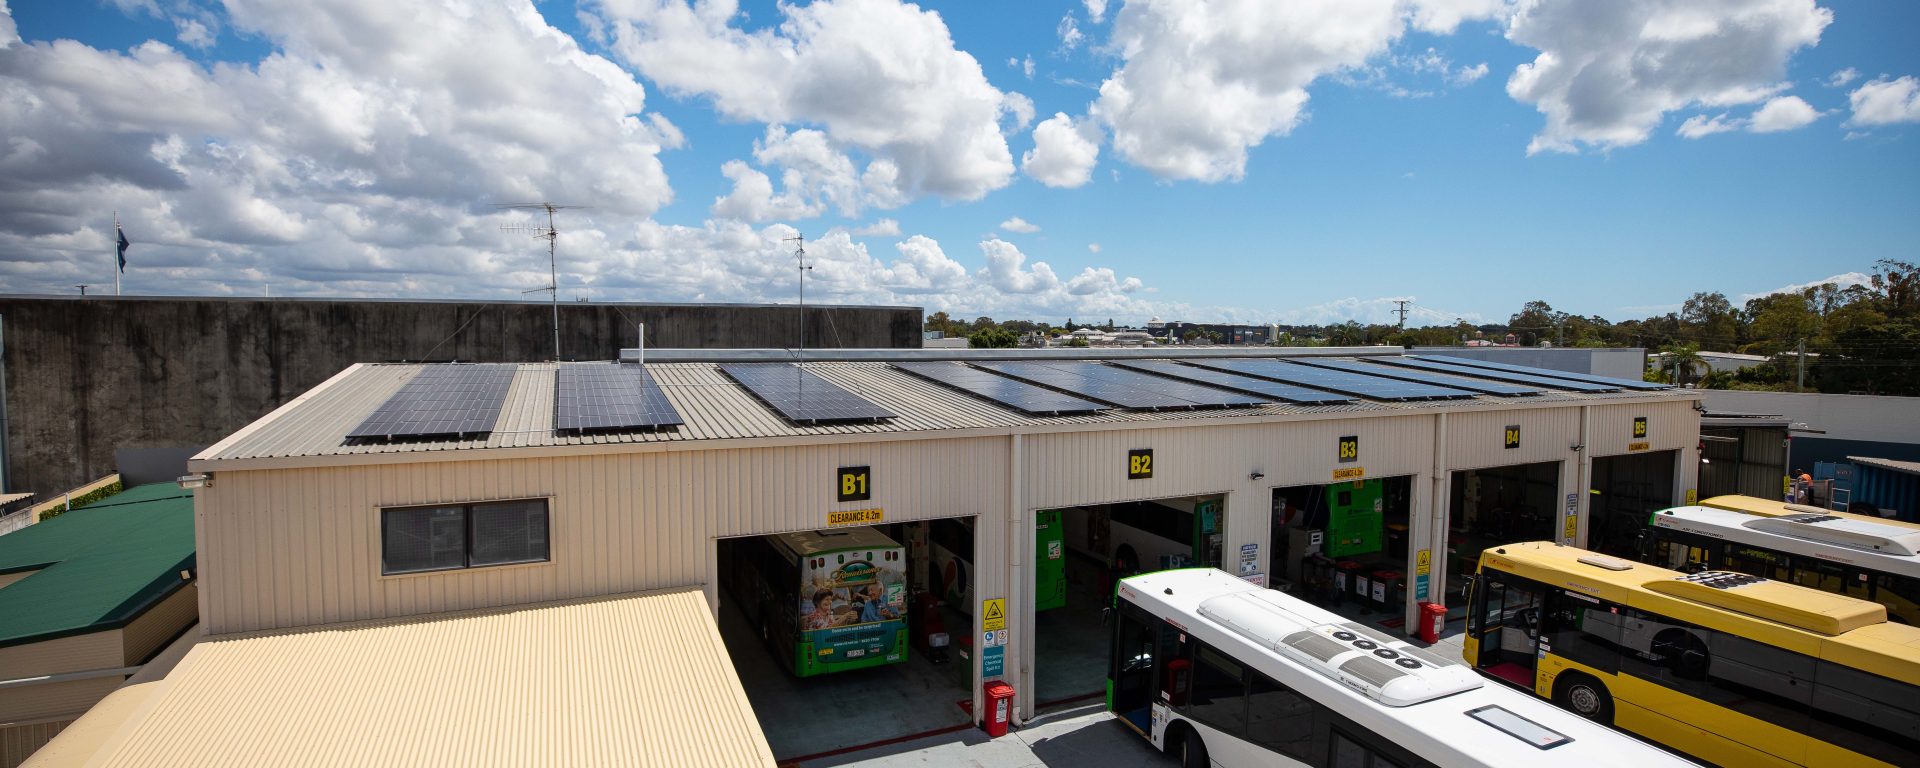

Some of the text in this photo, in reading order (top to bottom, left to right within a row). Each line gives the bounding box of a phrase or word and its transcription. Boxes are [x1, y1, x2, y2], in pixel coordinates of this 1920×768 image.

[1635, 421, 1646, 434] B5
[1506, 430, 1519, 444] B4
[1340, 441, 1356, 458] B3
[1130, 455, 1151, 474] B2
[842, 473, 866, 495] B1
[830, 510, 881, 524] CLEARANCE 4.2m
[1691, 529, 1724, 538] CONDITIONED
